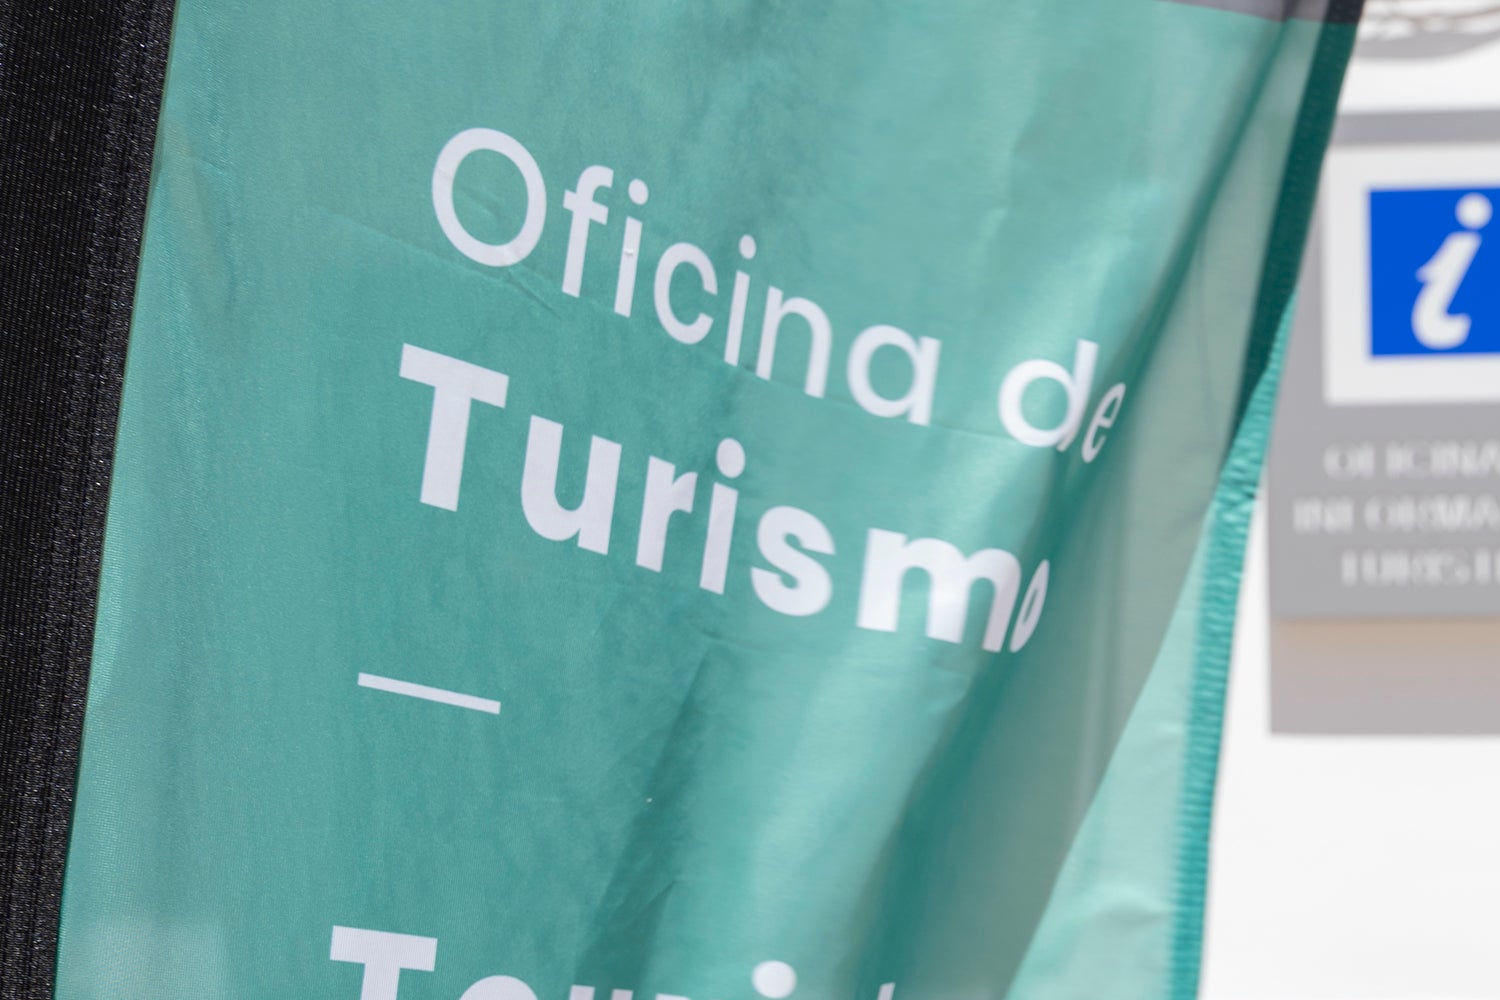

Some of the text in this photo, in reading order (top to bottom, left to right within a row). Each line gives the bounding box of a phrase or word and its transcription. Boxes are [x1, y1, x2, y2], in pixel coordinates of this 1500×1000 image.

[431, 126, 1126, 464] Oficina de
[399, 341, 1051, 653] Turismo
